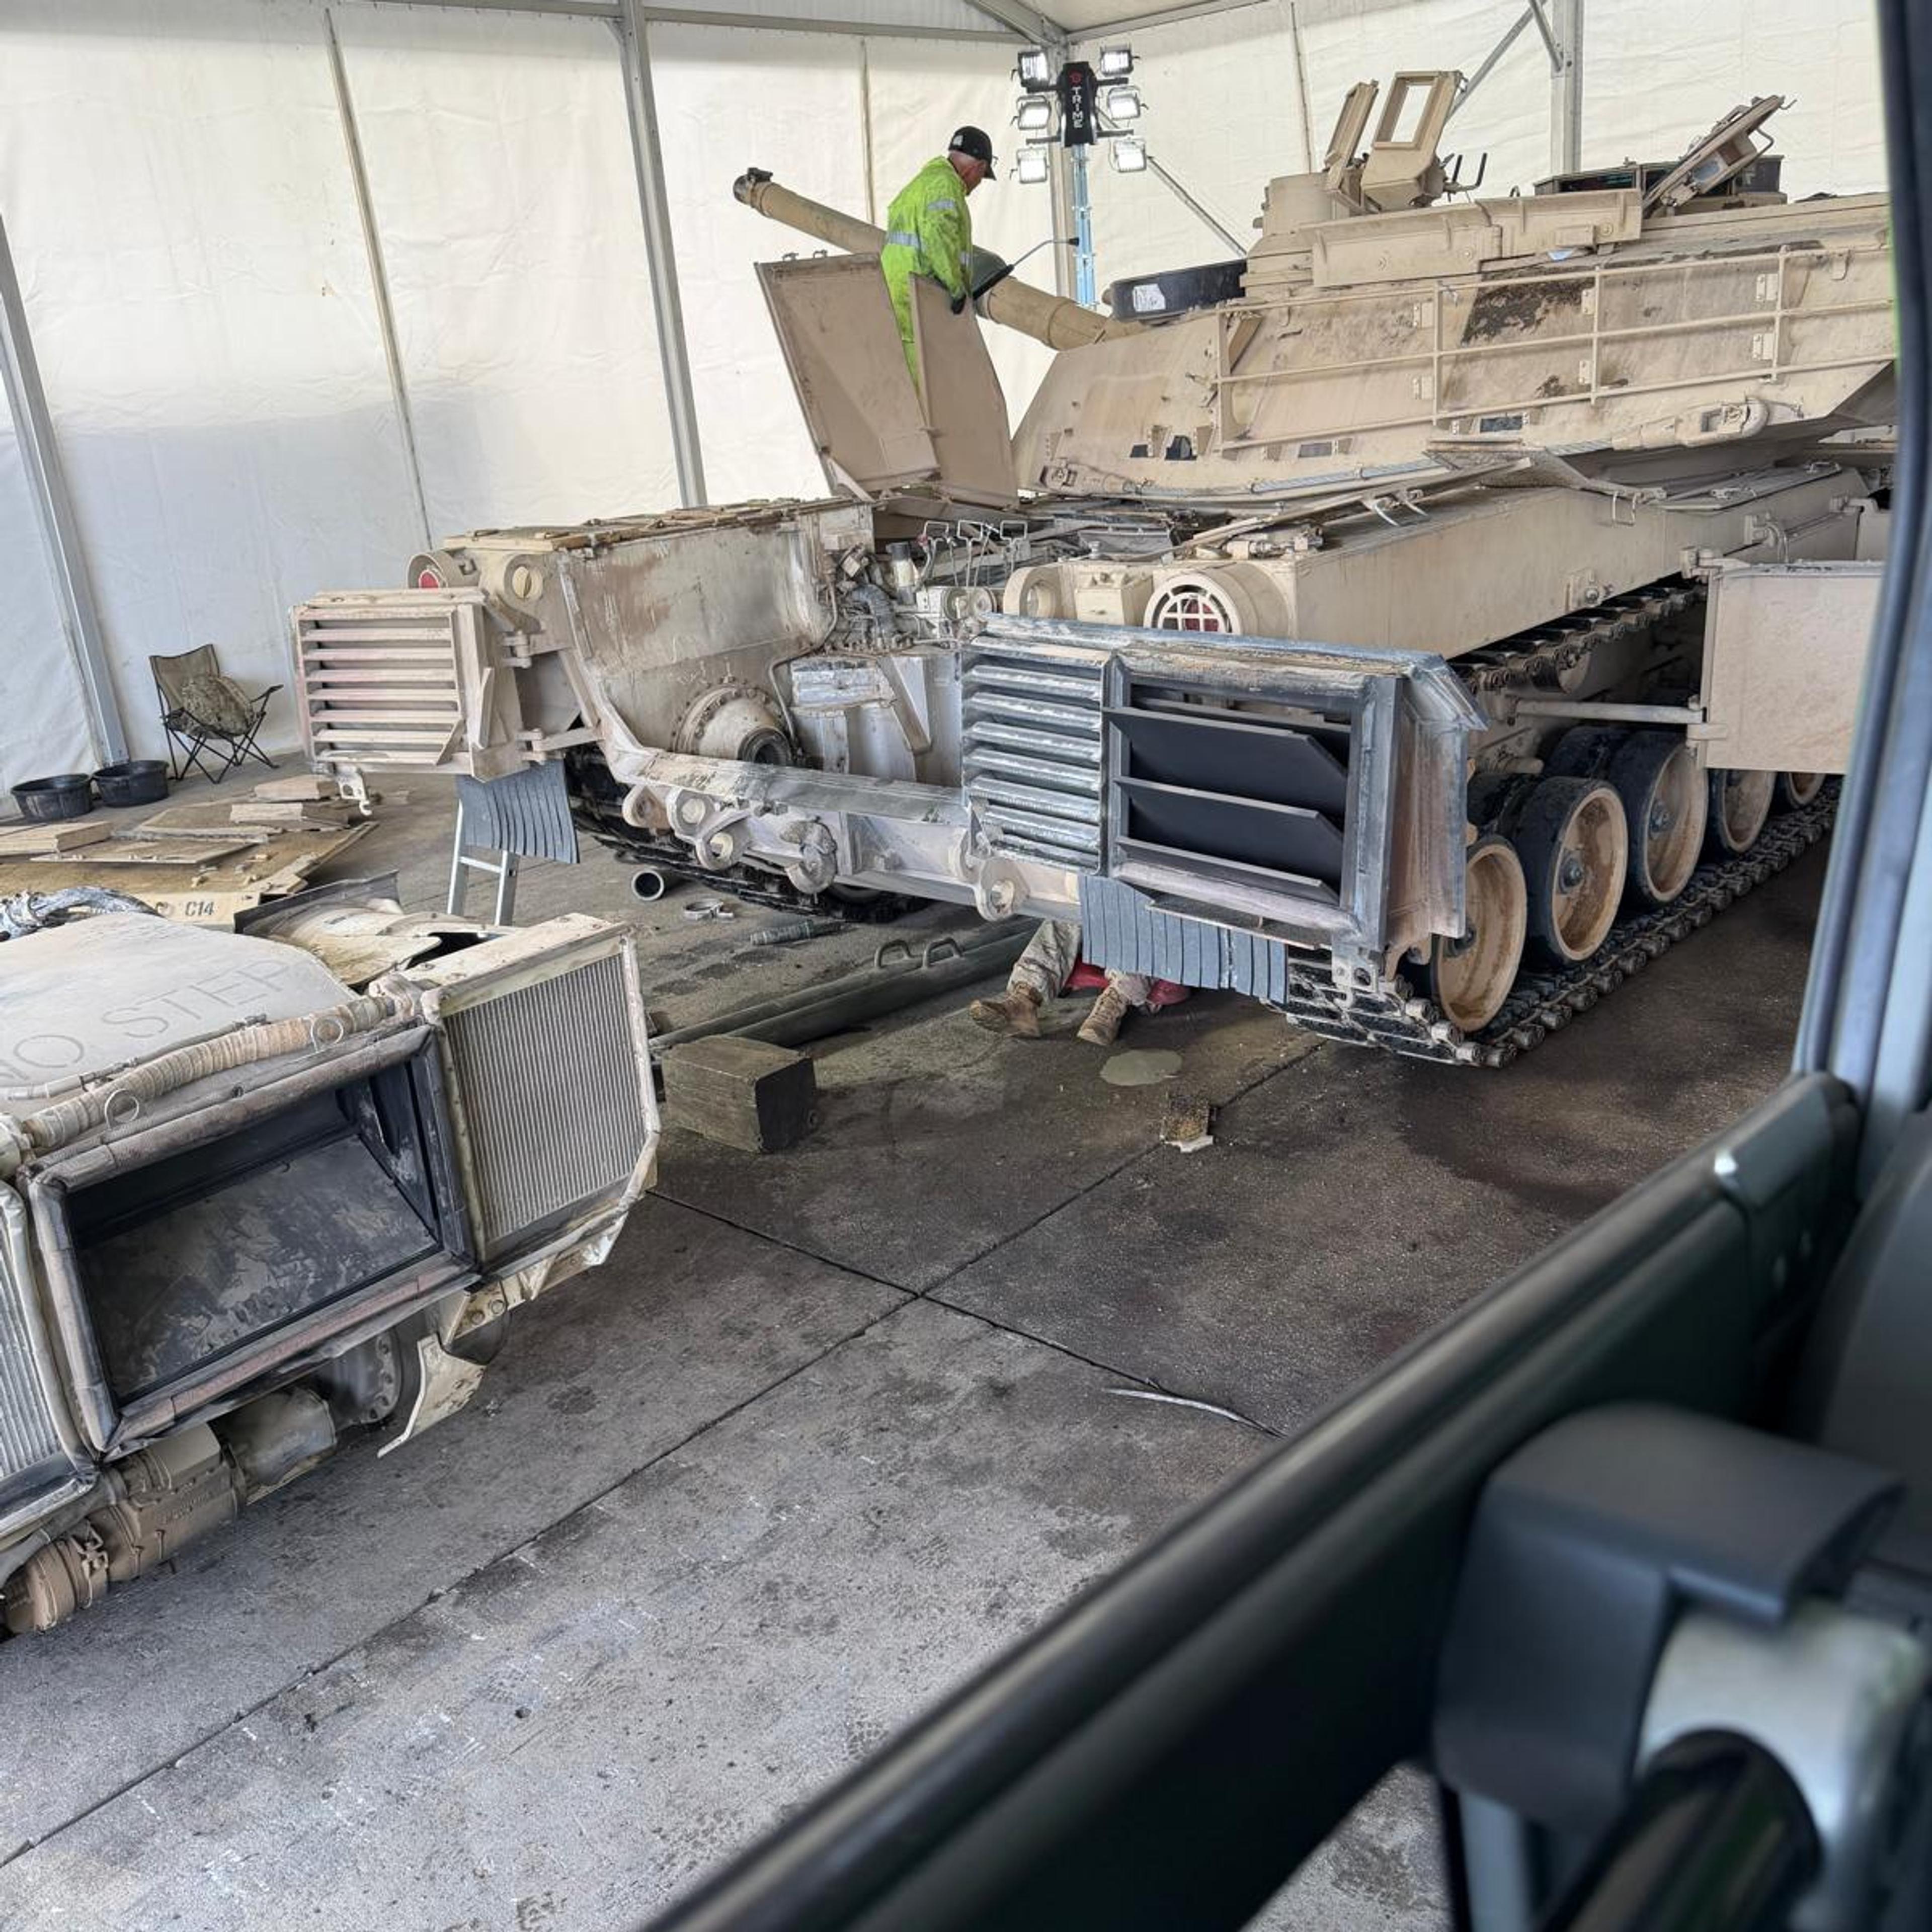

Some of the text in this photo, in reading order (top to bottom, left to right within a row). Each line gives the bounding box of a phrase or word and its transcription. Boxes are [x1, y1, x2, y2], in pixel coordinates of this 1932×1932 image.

[1072, 86, 1083, 128] TRIME
[185, 901, 214, 916] C14
[102, 960, 290, 1037] STEP
